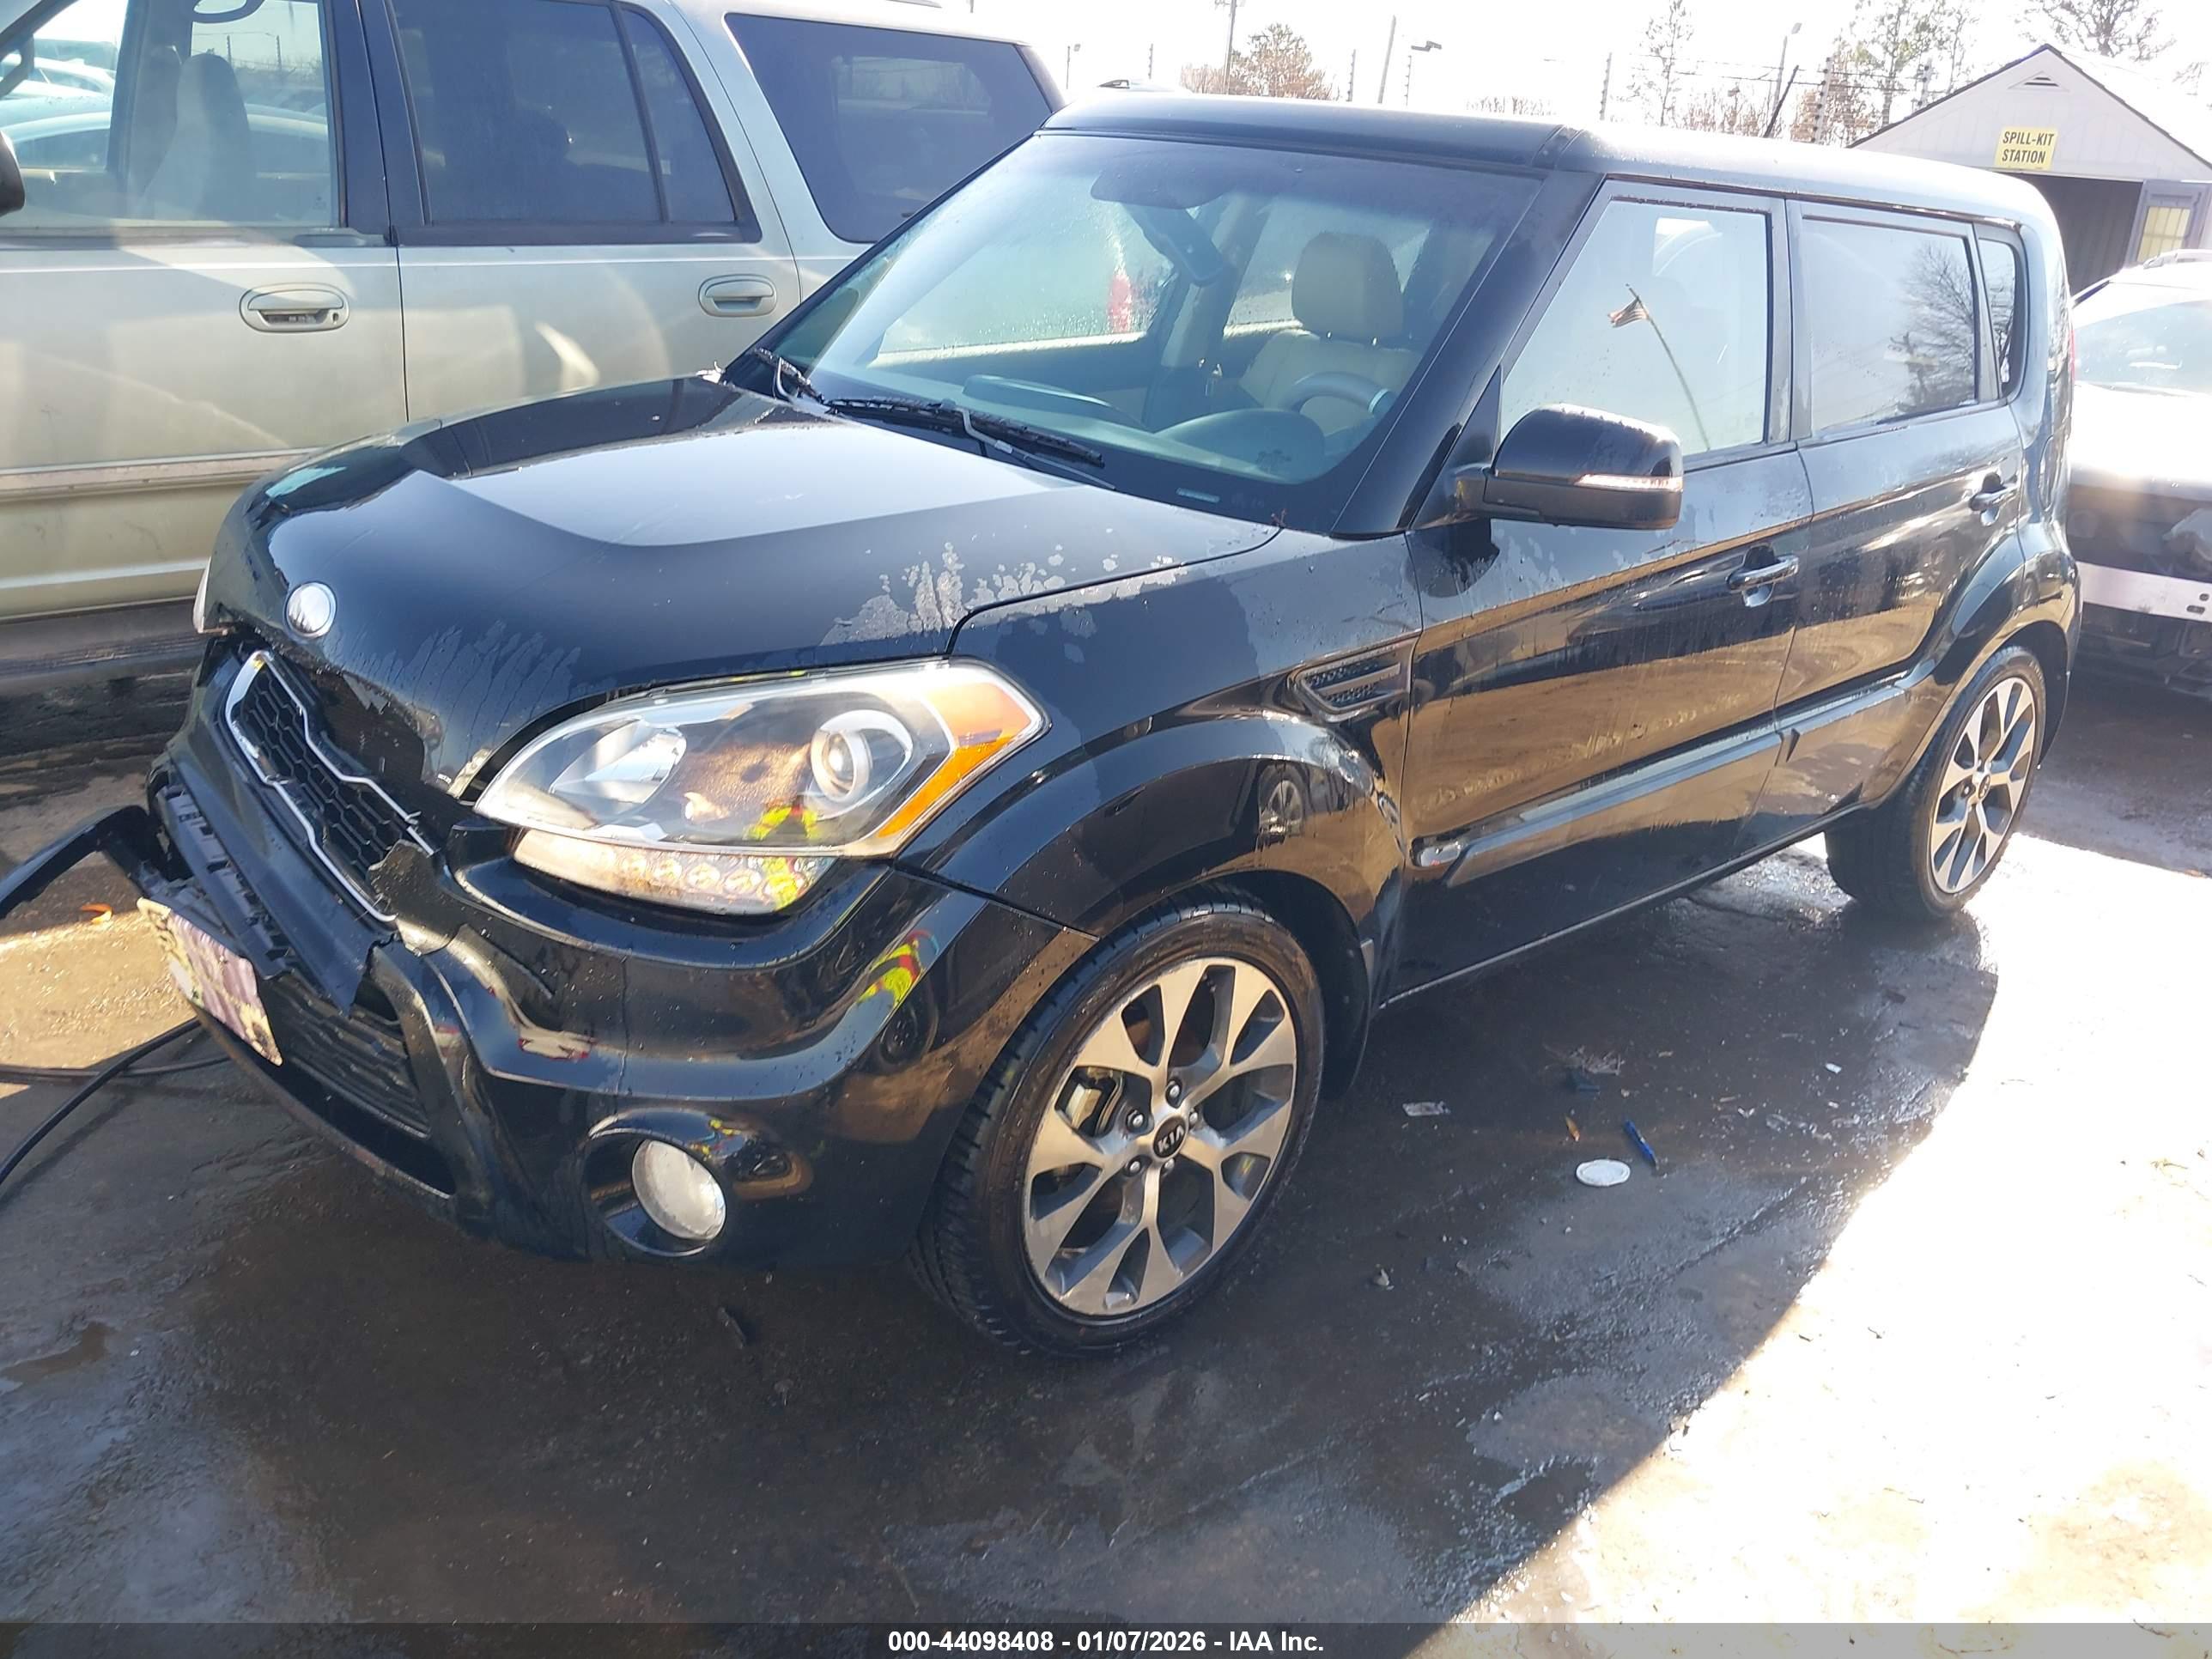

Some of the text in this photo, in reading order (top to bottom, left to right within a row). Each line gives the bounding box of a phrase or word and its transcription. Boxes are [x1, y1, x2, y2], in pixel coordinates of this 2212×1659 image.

[2002, 131, 2055, 146] SPILL-KIT
[2002, 149, 2046, 164] STATION
[1158, 1125, 1184, 1153] KIA
